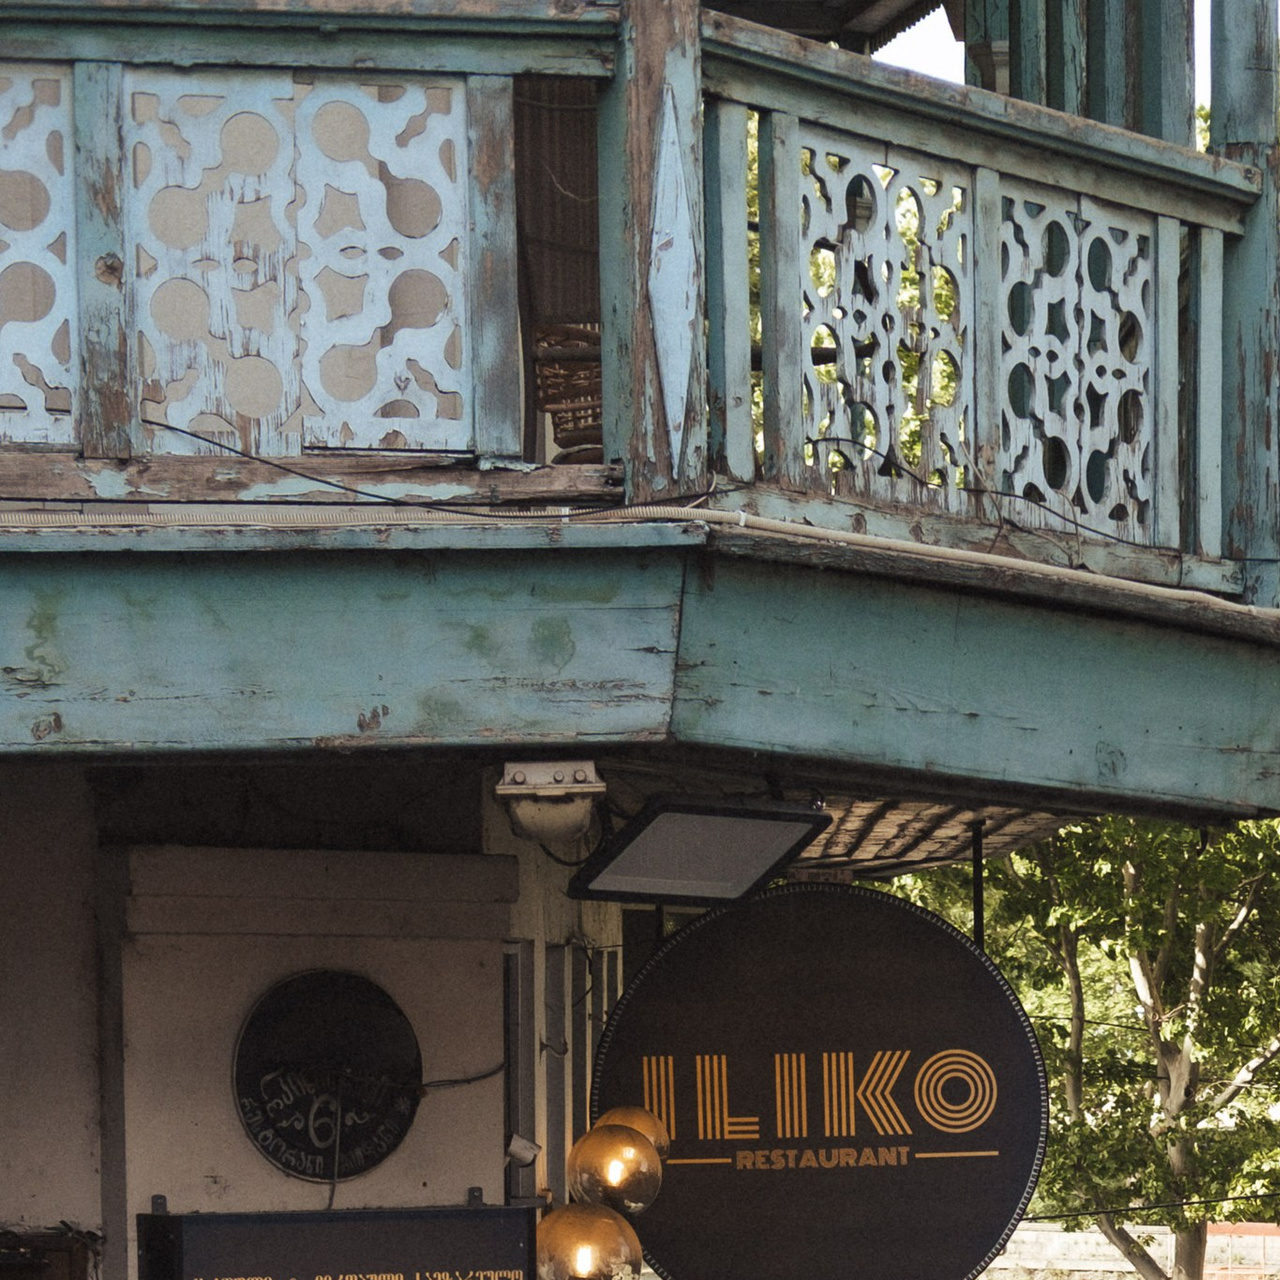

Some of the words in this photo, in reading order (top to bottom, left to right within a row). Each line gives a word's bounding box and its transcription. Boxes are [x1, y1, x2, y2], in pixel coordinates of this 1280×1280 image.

[308, 1093, 337, 1149] 6
[642, 1048, 998, 1140] ILIKO
[735, 1145, 910, 1170] RESTAURANT
